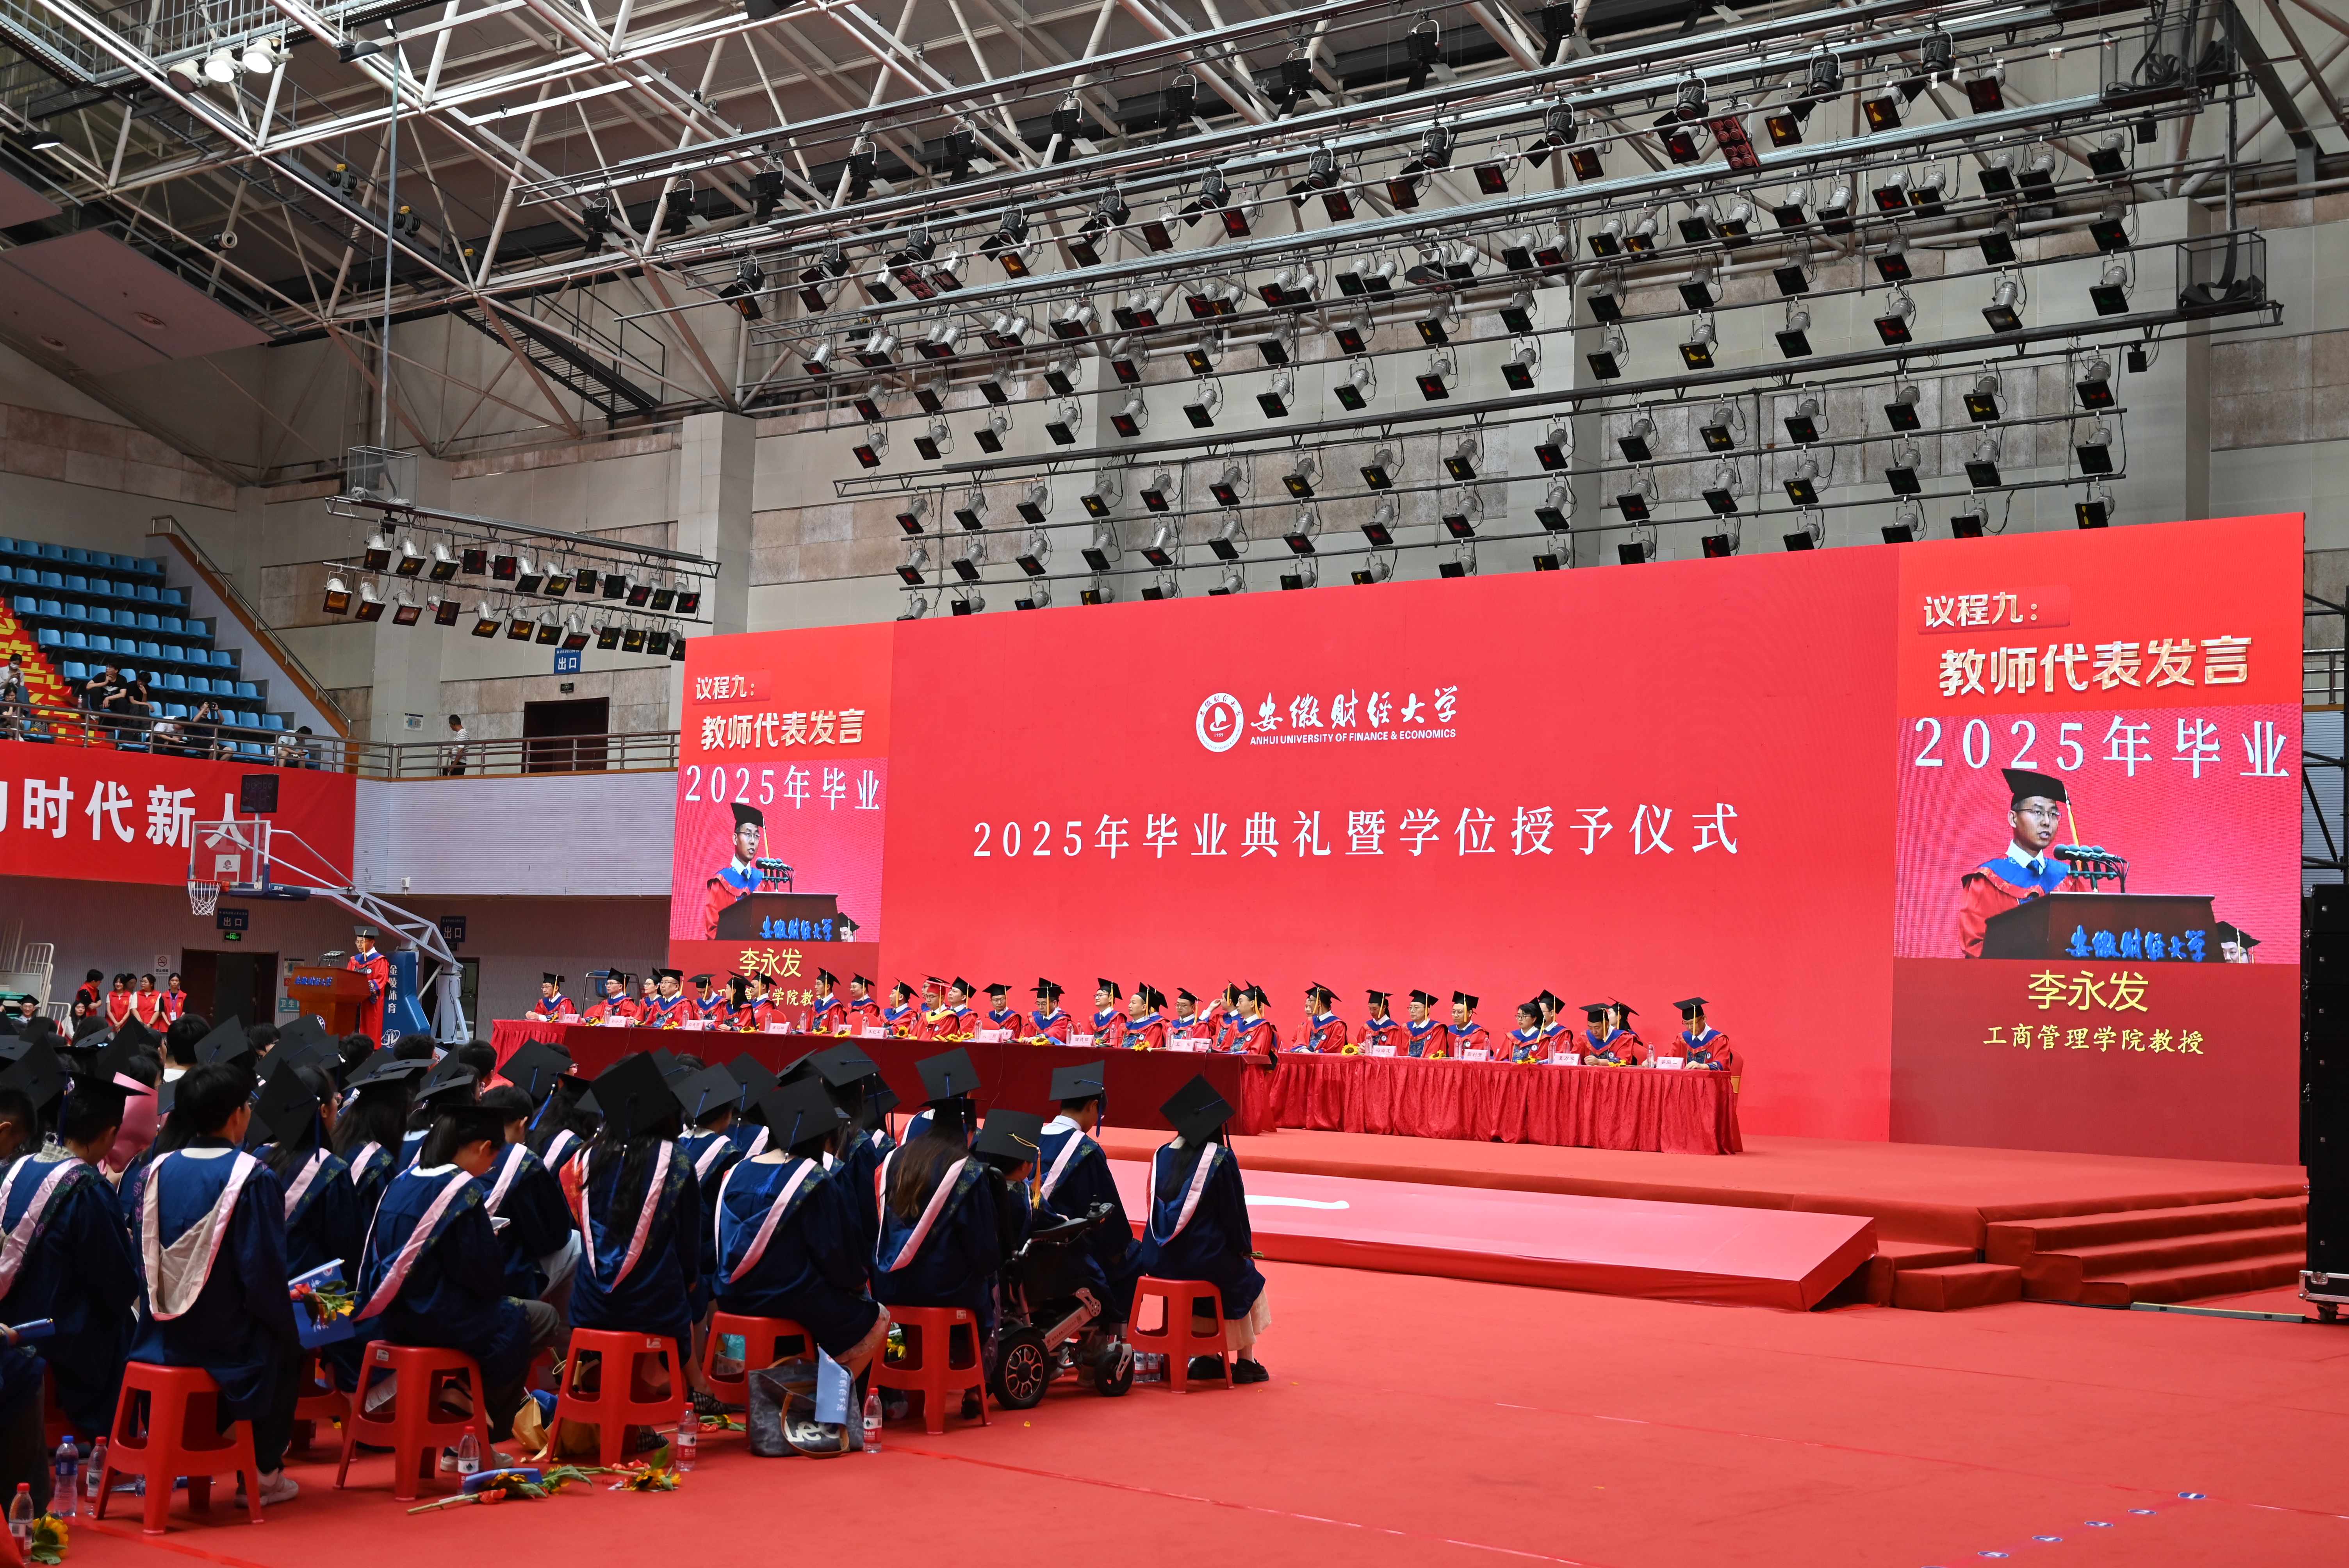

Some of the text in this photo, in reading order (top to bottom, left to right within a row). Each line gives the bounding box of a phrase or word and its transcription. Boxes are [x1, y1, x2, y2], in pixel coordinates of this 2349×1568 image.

[558, 657, 577, 670] 出口
[1939, 635, 2252, 696] 教师代表发言
[701, 709, 865, 750] 教师代表发言
[1251, 685, 1458, 732] 安徽财经大学
[1250, 729, 1456, 745] ANHUI UNIVERSITY OF FINANCE & ECONOMICS
[1915, 715, 2289, 778] 2025年毕业
[686, 764, 879, 810] 2025年毕业
[0, 777, 250, 851] 时代新人
[974, 803, 1738, 859] 2025年毕业典礼暨学位授予仪式
[223, 917, 242, 927] 出口
[444, 926, 462, 939] 出口
[739, 947, 802, 977] 李永发
[2066, 925, 2206, 962] 安徽财经大学
[387, 964, 397, 1014] 金陵体育
[2028, 969, 2148, 1012] 李永发
[1983, 1023, 2204, 1054] 工商管理学院教授
